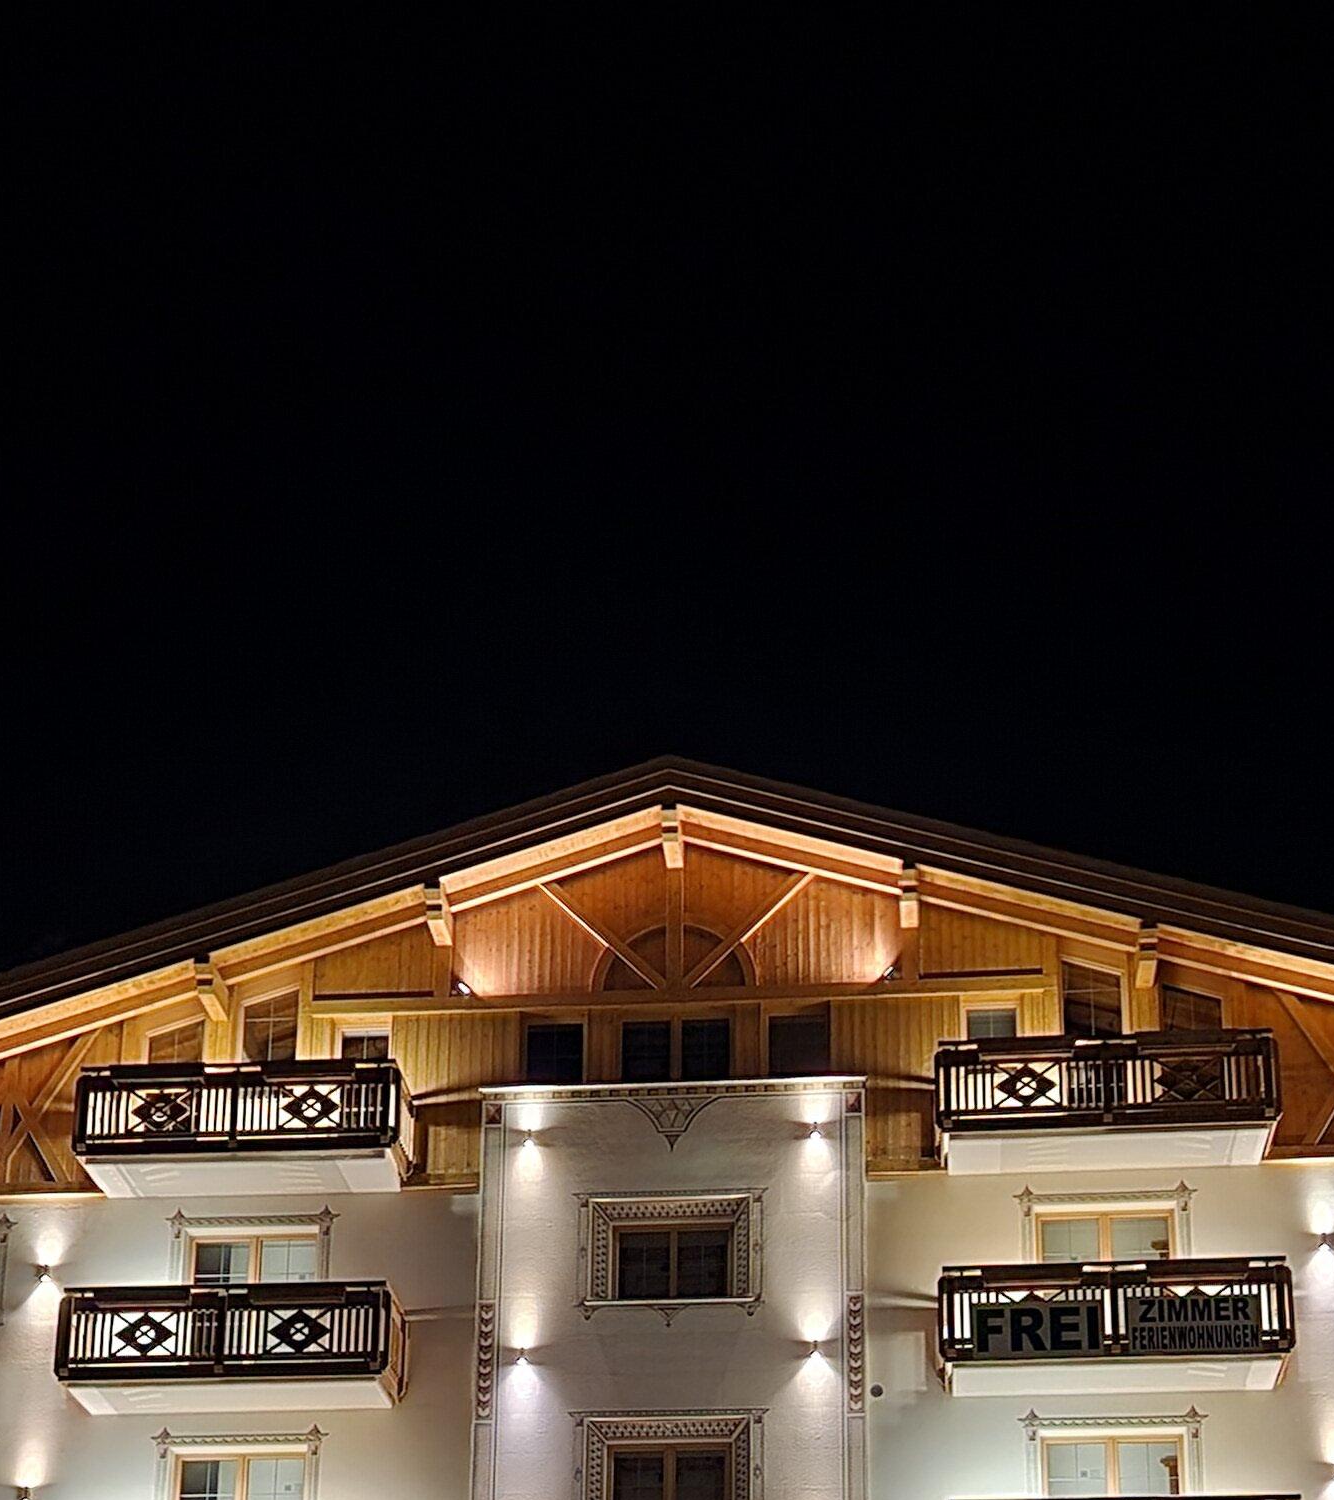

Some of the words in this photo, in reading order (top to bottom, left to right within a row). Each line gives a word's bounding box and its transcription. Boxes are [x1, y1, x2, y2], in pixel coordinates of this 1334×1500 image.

[1139, 1297, 1251, 1323] ZIMMER
[976, 1305, 1101, 1353] FREI
[1131, 1323, 1260, 1351] FERIENWOHNUNGEN
